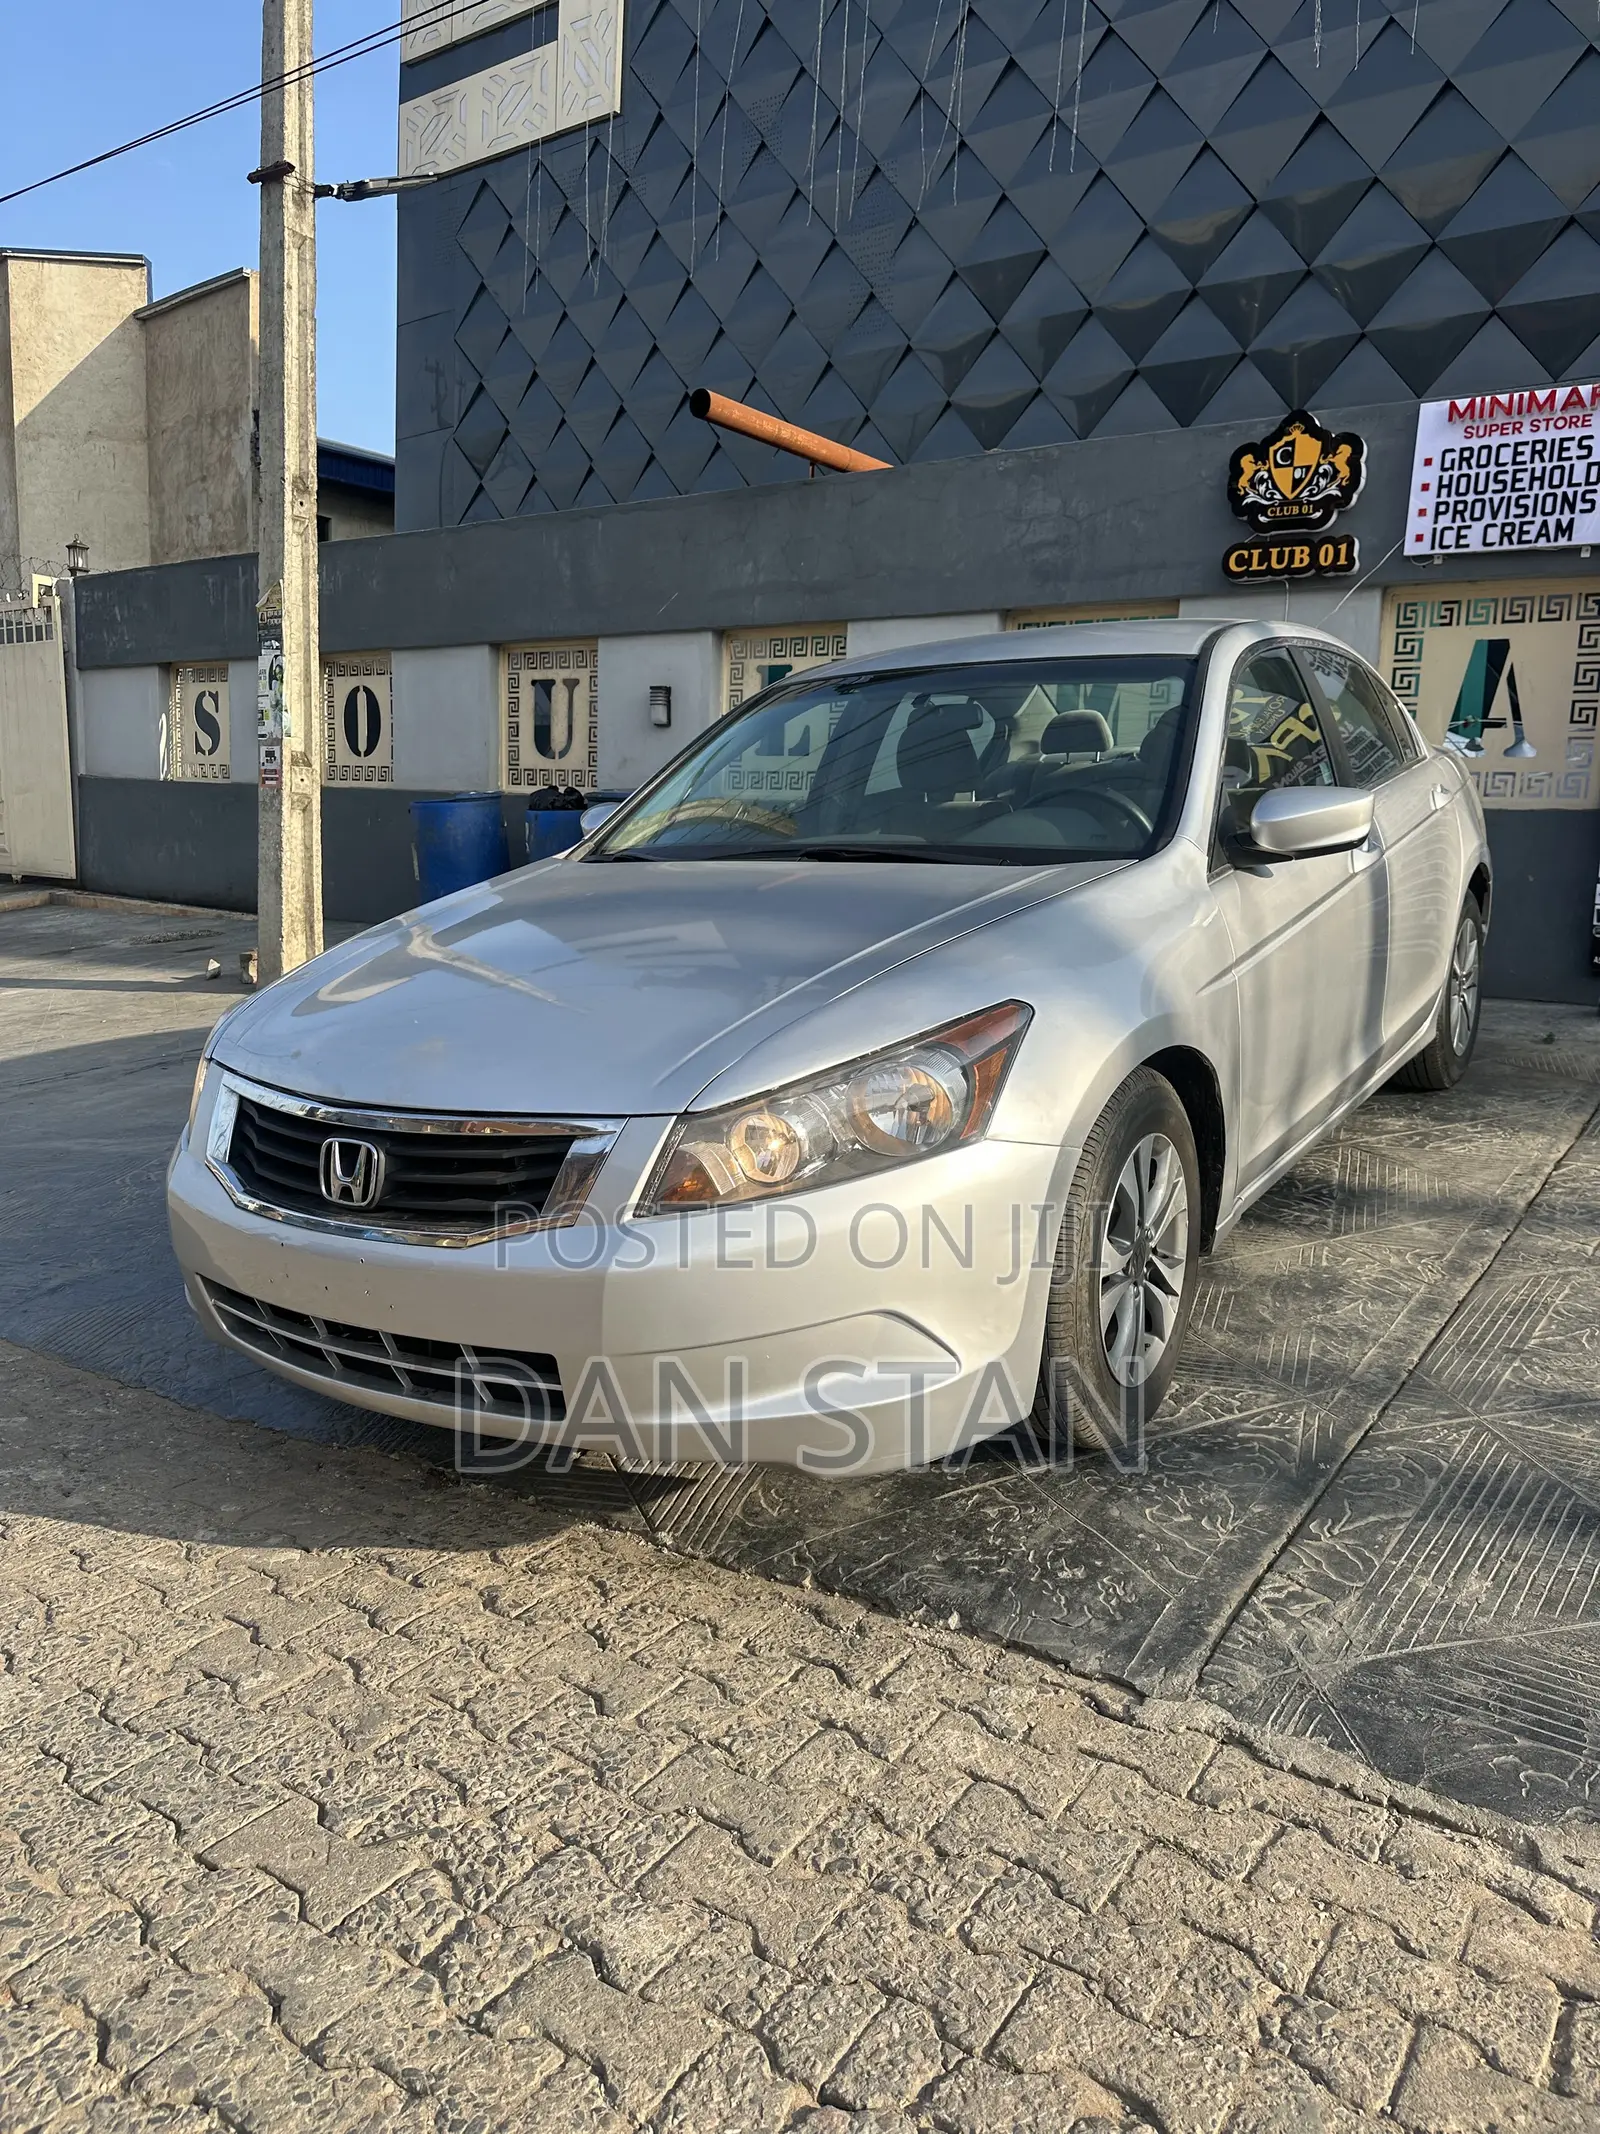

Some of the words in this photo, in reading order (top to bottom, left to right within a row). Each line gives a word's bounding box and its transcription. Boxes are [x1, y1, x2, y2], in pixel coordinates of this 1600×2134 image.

[1463, 421, 1523, 440] SUPER
[1530, 413, 1594, 433] STORE
[1276, 446, 1292, 465] C
[1440, 434, 1595, 473] GROCERIES
[1436, 460, 1600, 499] HOUSEHOLD
[1267, 506, 1299, 517] CLUB
[1302, 504, 1314, 514] 01
[1433, 488, 1598, 525] PROVISIONS
[1429, 524, 1472, 551] ICE
[1482, 517, 1575, 548] CREAM
[1228, 546, 1310, 573] CLUB
[1319, 543, 1349, 567] 01
[194, 689, 221, 757] S
[530, 678, 580, 760] U
